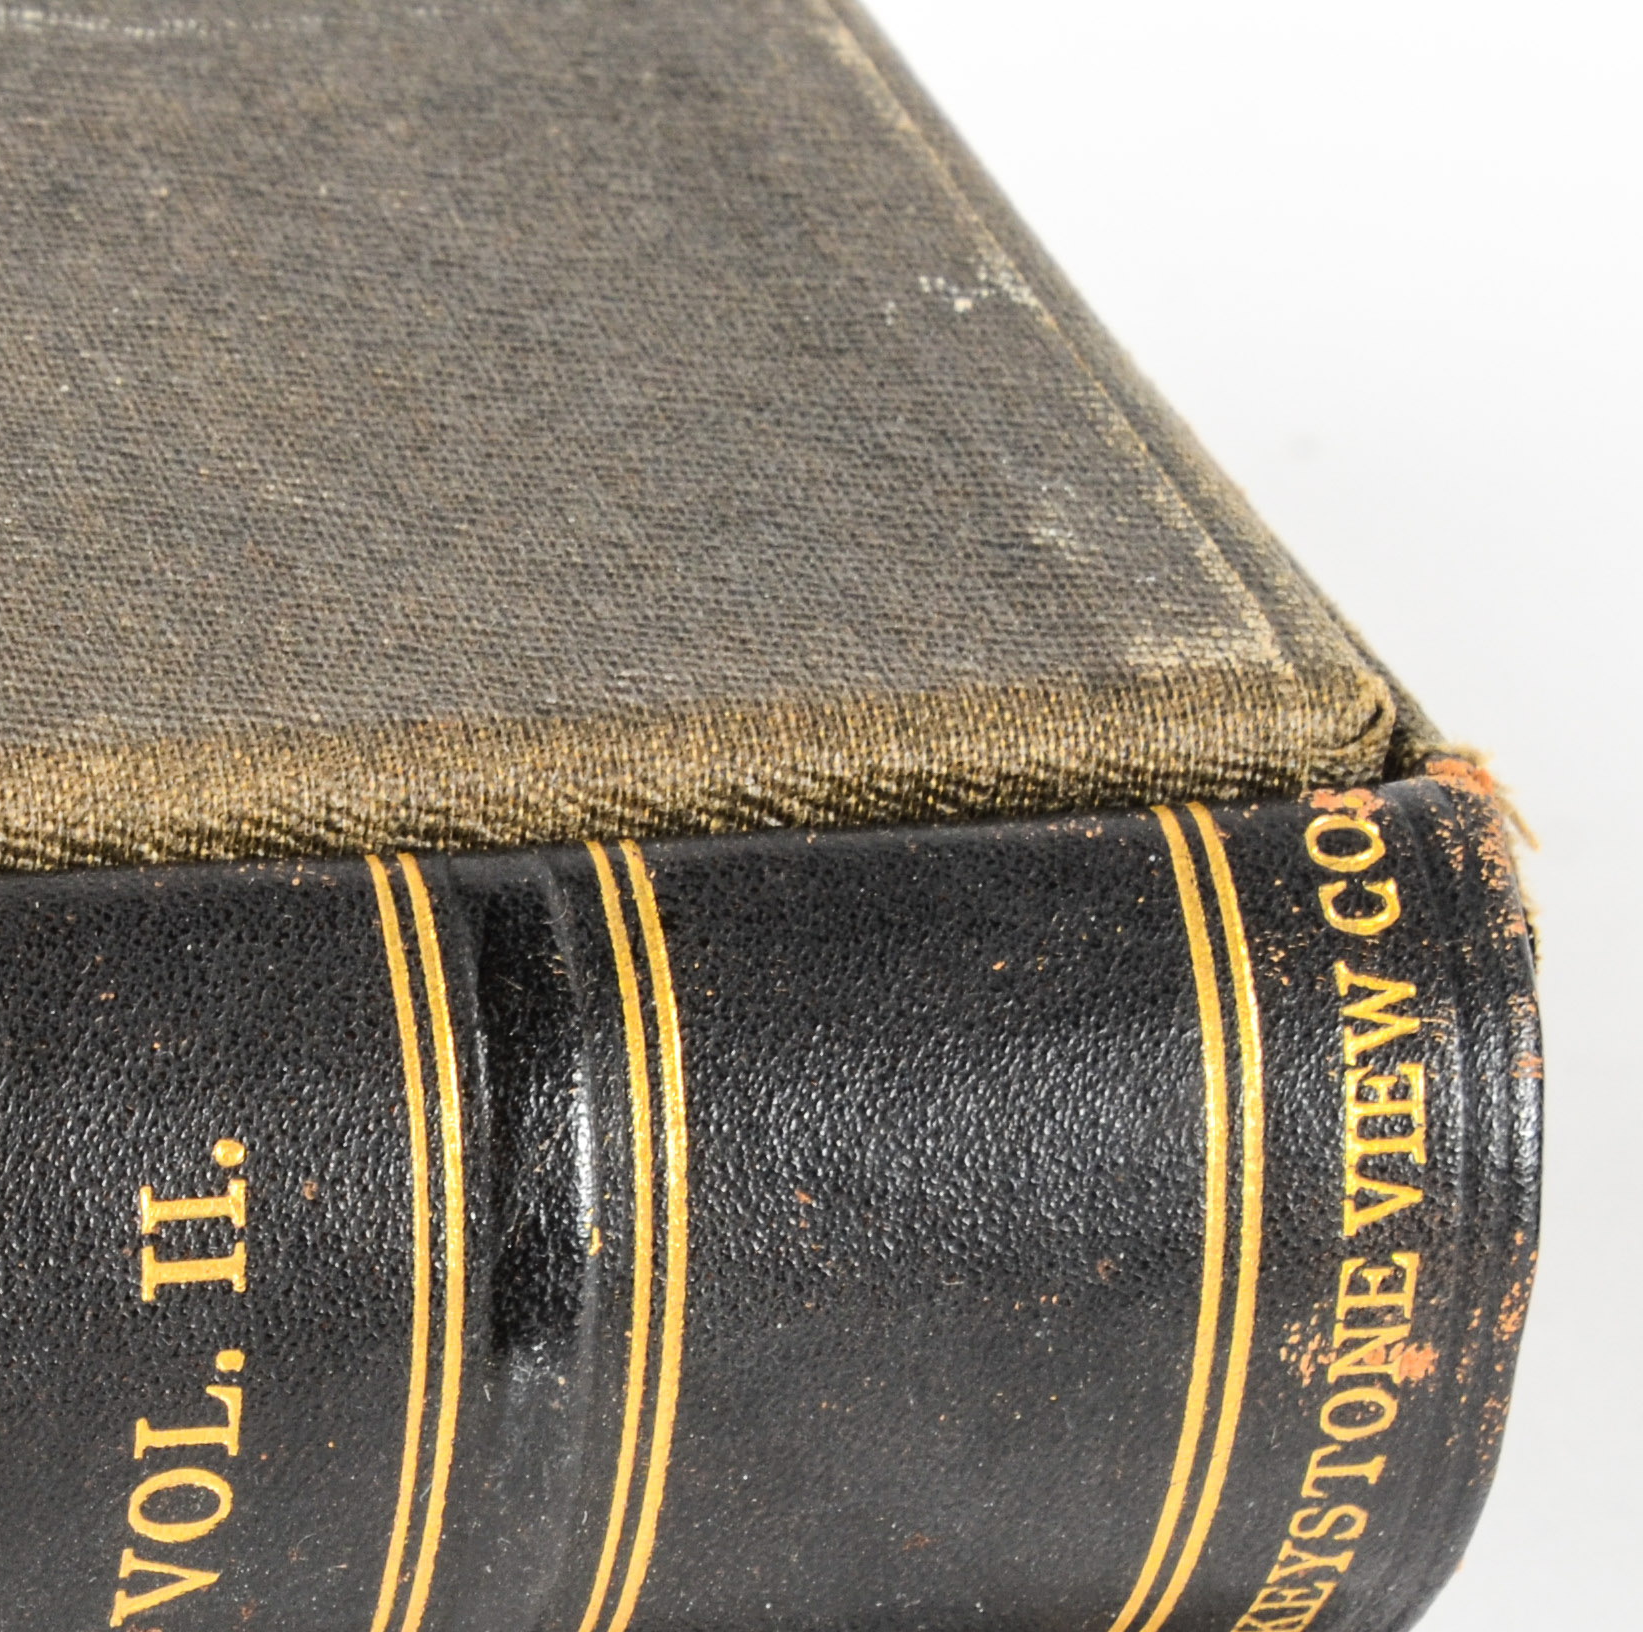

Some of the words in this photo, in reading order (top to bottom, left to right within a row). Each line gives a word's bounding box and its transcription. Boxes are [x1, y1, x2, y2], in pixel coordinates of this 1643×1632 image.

[139, 1137, 247, 1302] II.
[1333, 960, 1427, 1237] VIEW
[110, 1348, 245, 1627] VOL.
